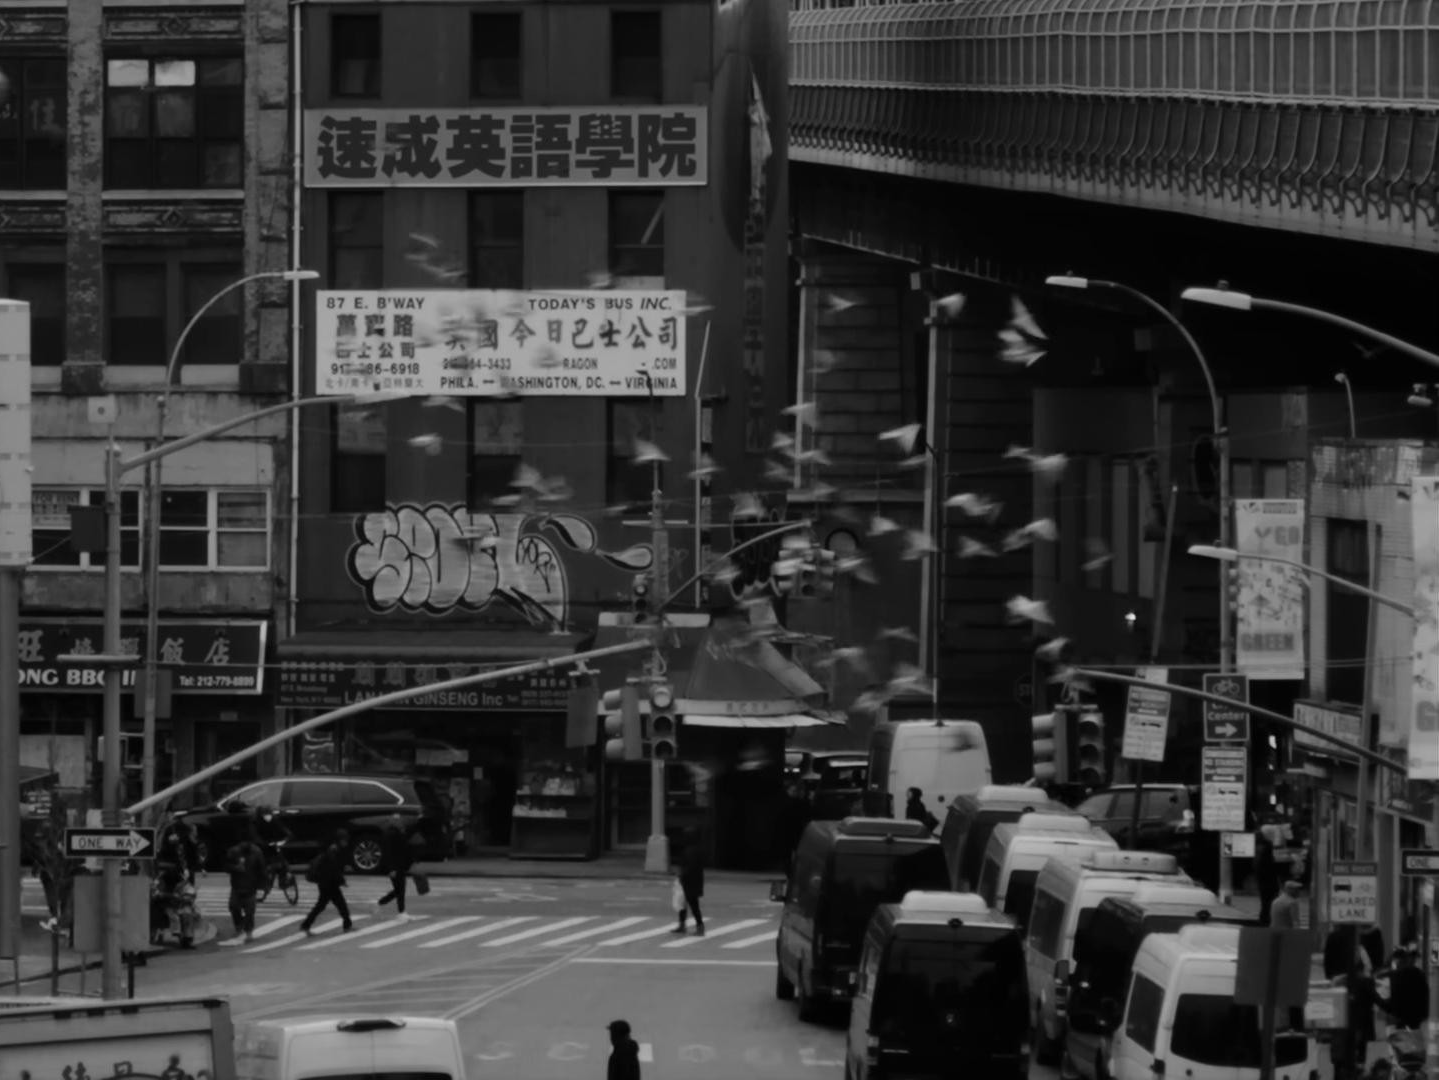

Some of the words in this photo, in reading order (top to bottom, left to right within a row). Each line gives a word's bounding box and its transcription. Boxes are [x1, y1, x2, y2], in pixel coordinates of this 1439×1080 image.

[317, 112, 698, 180] 速成英語學院
[326, 297, 345, 309] 87
[377, 297, 425, 309] B'WAY
[529, 298, 596, 311] TODAY'S
[640, 297, 672, 310] INC.
[440, 377, 478, 389] PHILA.
[586, 377, 606, 388] DC.
[625, 377, 678, 389] VIRGINIA
[413, 691, 479, 706] GINSENG
[482, 692, 504, 705] Inc
[78, 837, 102, 848] ONE
[116, 837, 142, 848] WAY
[1332, 897, 1376, 907] SHARED
[1339, 910, 1367, 919] LANE
